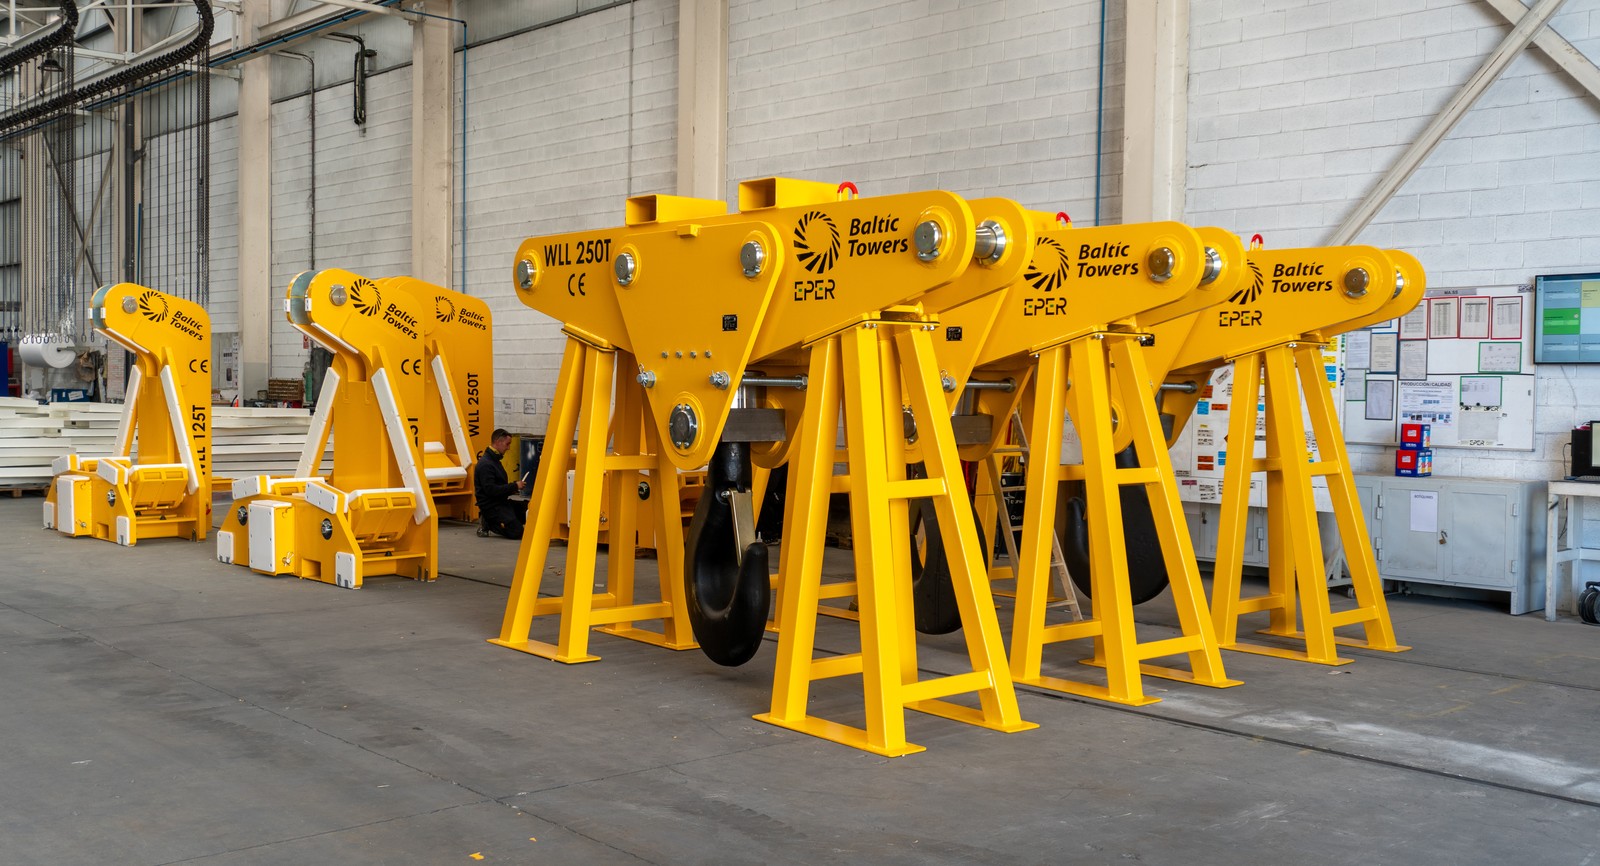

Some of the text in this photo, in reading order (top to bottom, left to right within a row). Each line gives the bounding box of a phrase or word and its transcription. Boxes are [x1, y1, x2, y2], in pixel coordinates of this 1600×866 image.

[849, 213, 900, 237] Baltic
[544, 238, 612, 267] WLL 250T
[848, 238, 909, 258] Towers
[1078, 242, 1130, 260] Baltic
[1077, 262, 1139, 278] Towers
[1273, 262, 1324, 278] Baltic
[794, 278, 836, 302] EPER
[1271, 280, 1333, 293] Towers
[387, 303, 418, 327] Baltic
[460, 308, 484, 322] Baltic
[1024, 297, 1067, 316] EPER
[174, 310, 203, 330] Baltic
[382, 311, 418, 340] Towers
[458, 315, 487, 331] Towers
[1219, 310, 1263, 327] EPER
[169, 317, 204, 341] Towers
[467, 373, 480, 437] WLL 250T
[192, 404, 206, 440] 125T
